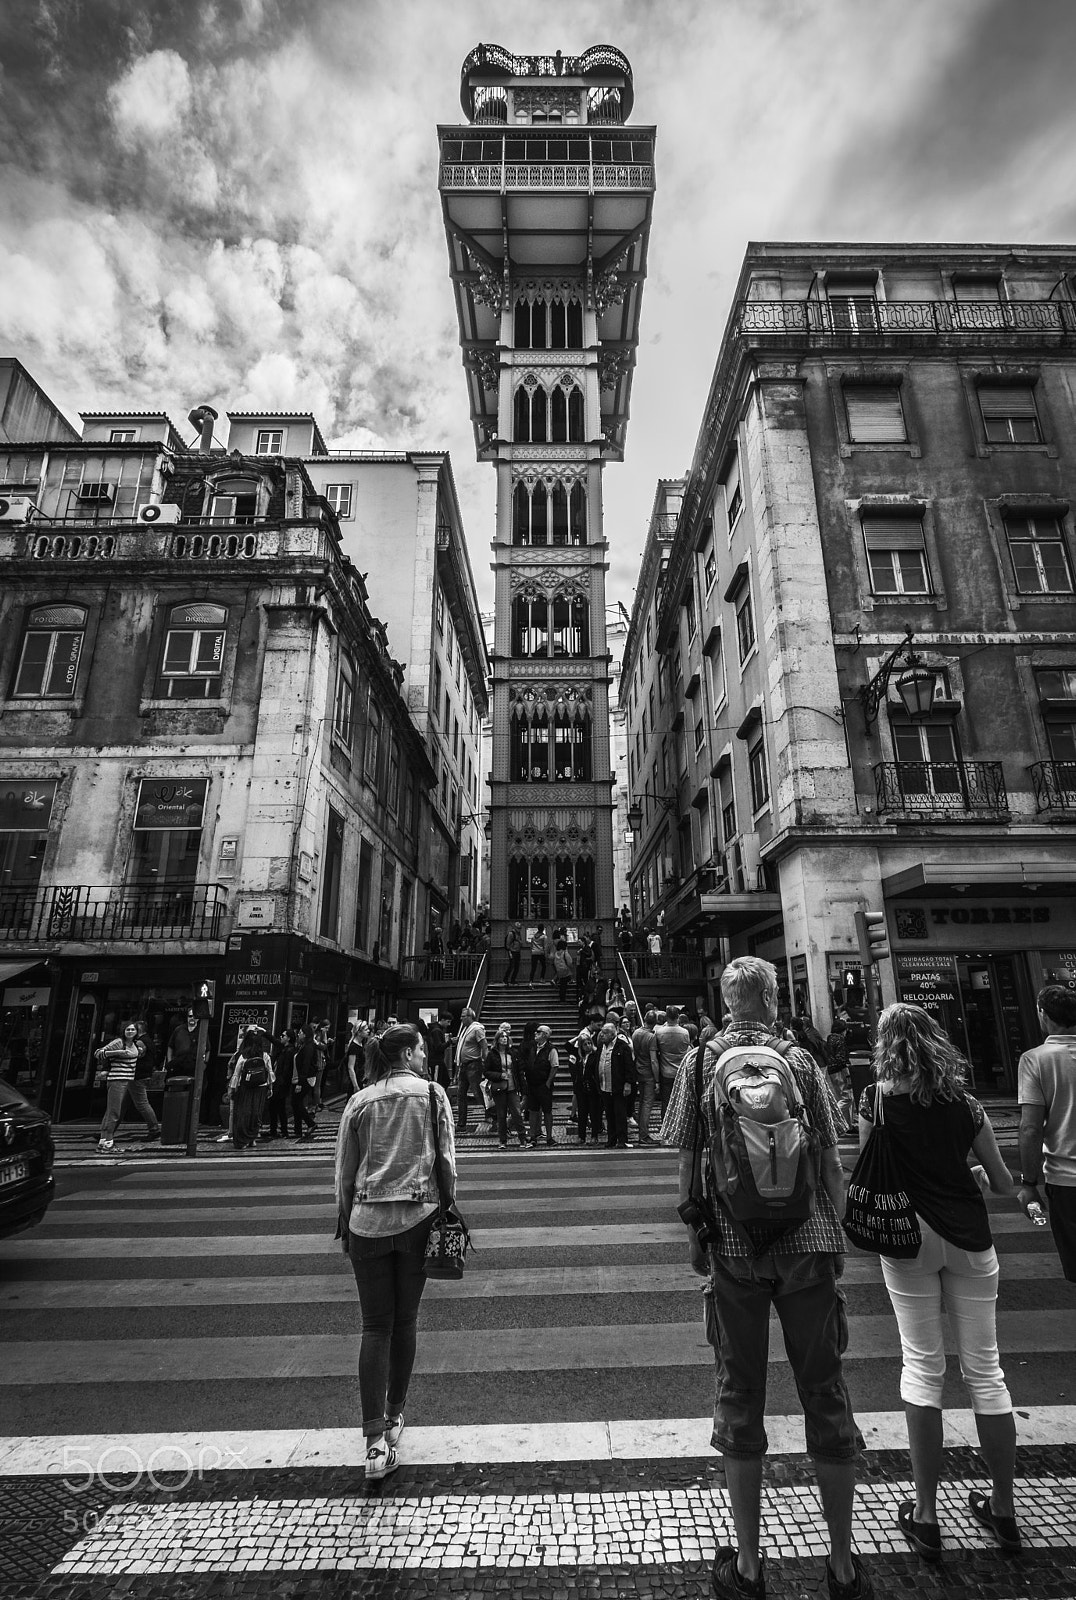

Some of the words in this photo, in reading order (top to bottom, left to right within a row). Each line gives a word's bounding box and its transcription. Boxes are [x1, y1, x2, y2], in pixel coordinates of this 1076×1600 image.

[212, 634, 223, 661] DIGITAL
[65, 664, 75, 684] FOTO
[157, 803, 185, 811] Oriental
[930, 906, 1050, 924] TORRES
[910, 973, 941, 982] PRATAS
[919, 981, 937, 989] 40%
[902, 993, 955, 1001] RELOJOARIA
[922, 1001, 940, 1010] 30%
[228, 1008, 259, 1018] ESPAÇO
[227, 1016, 269, 1025] SARMENTO
